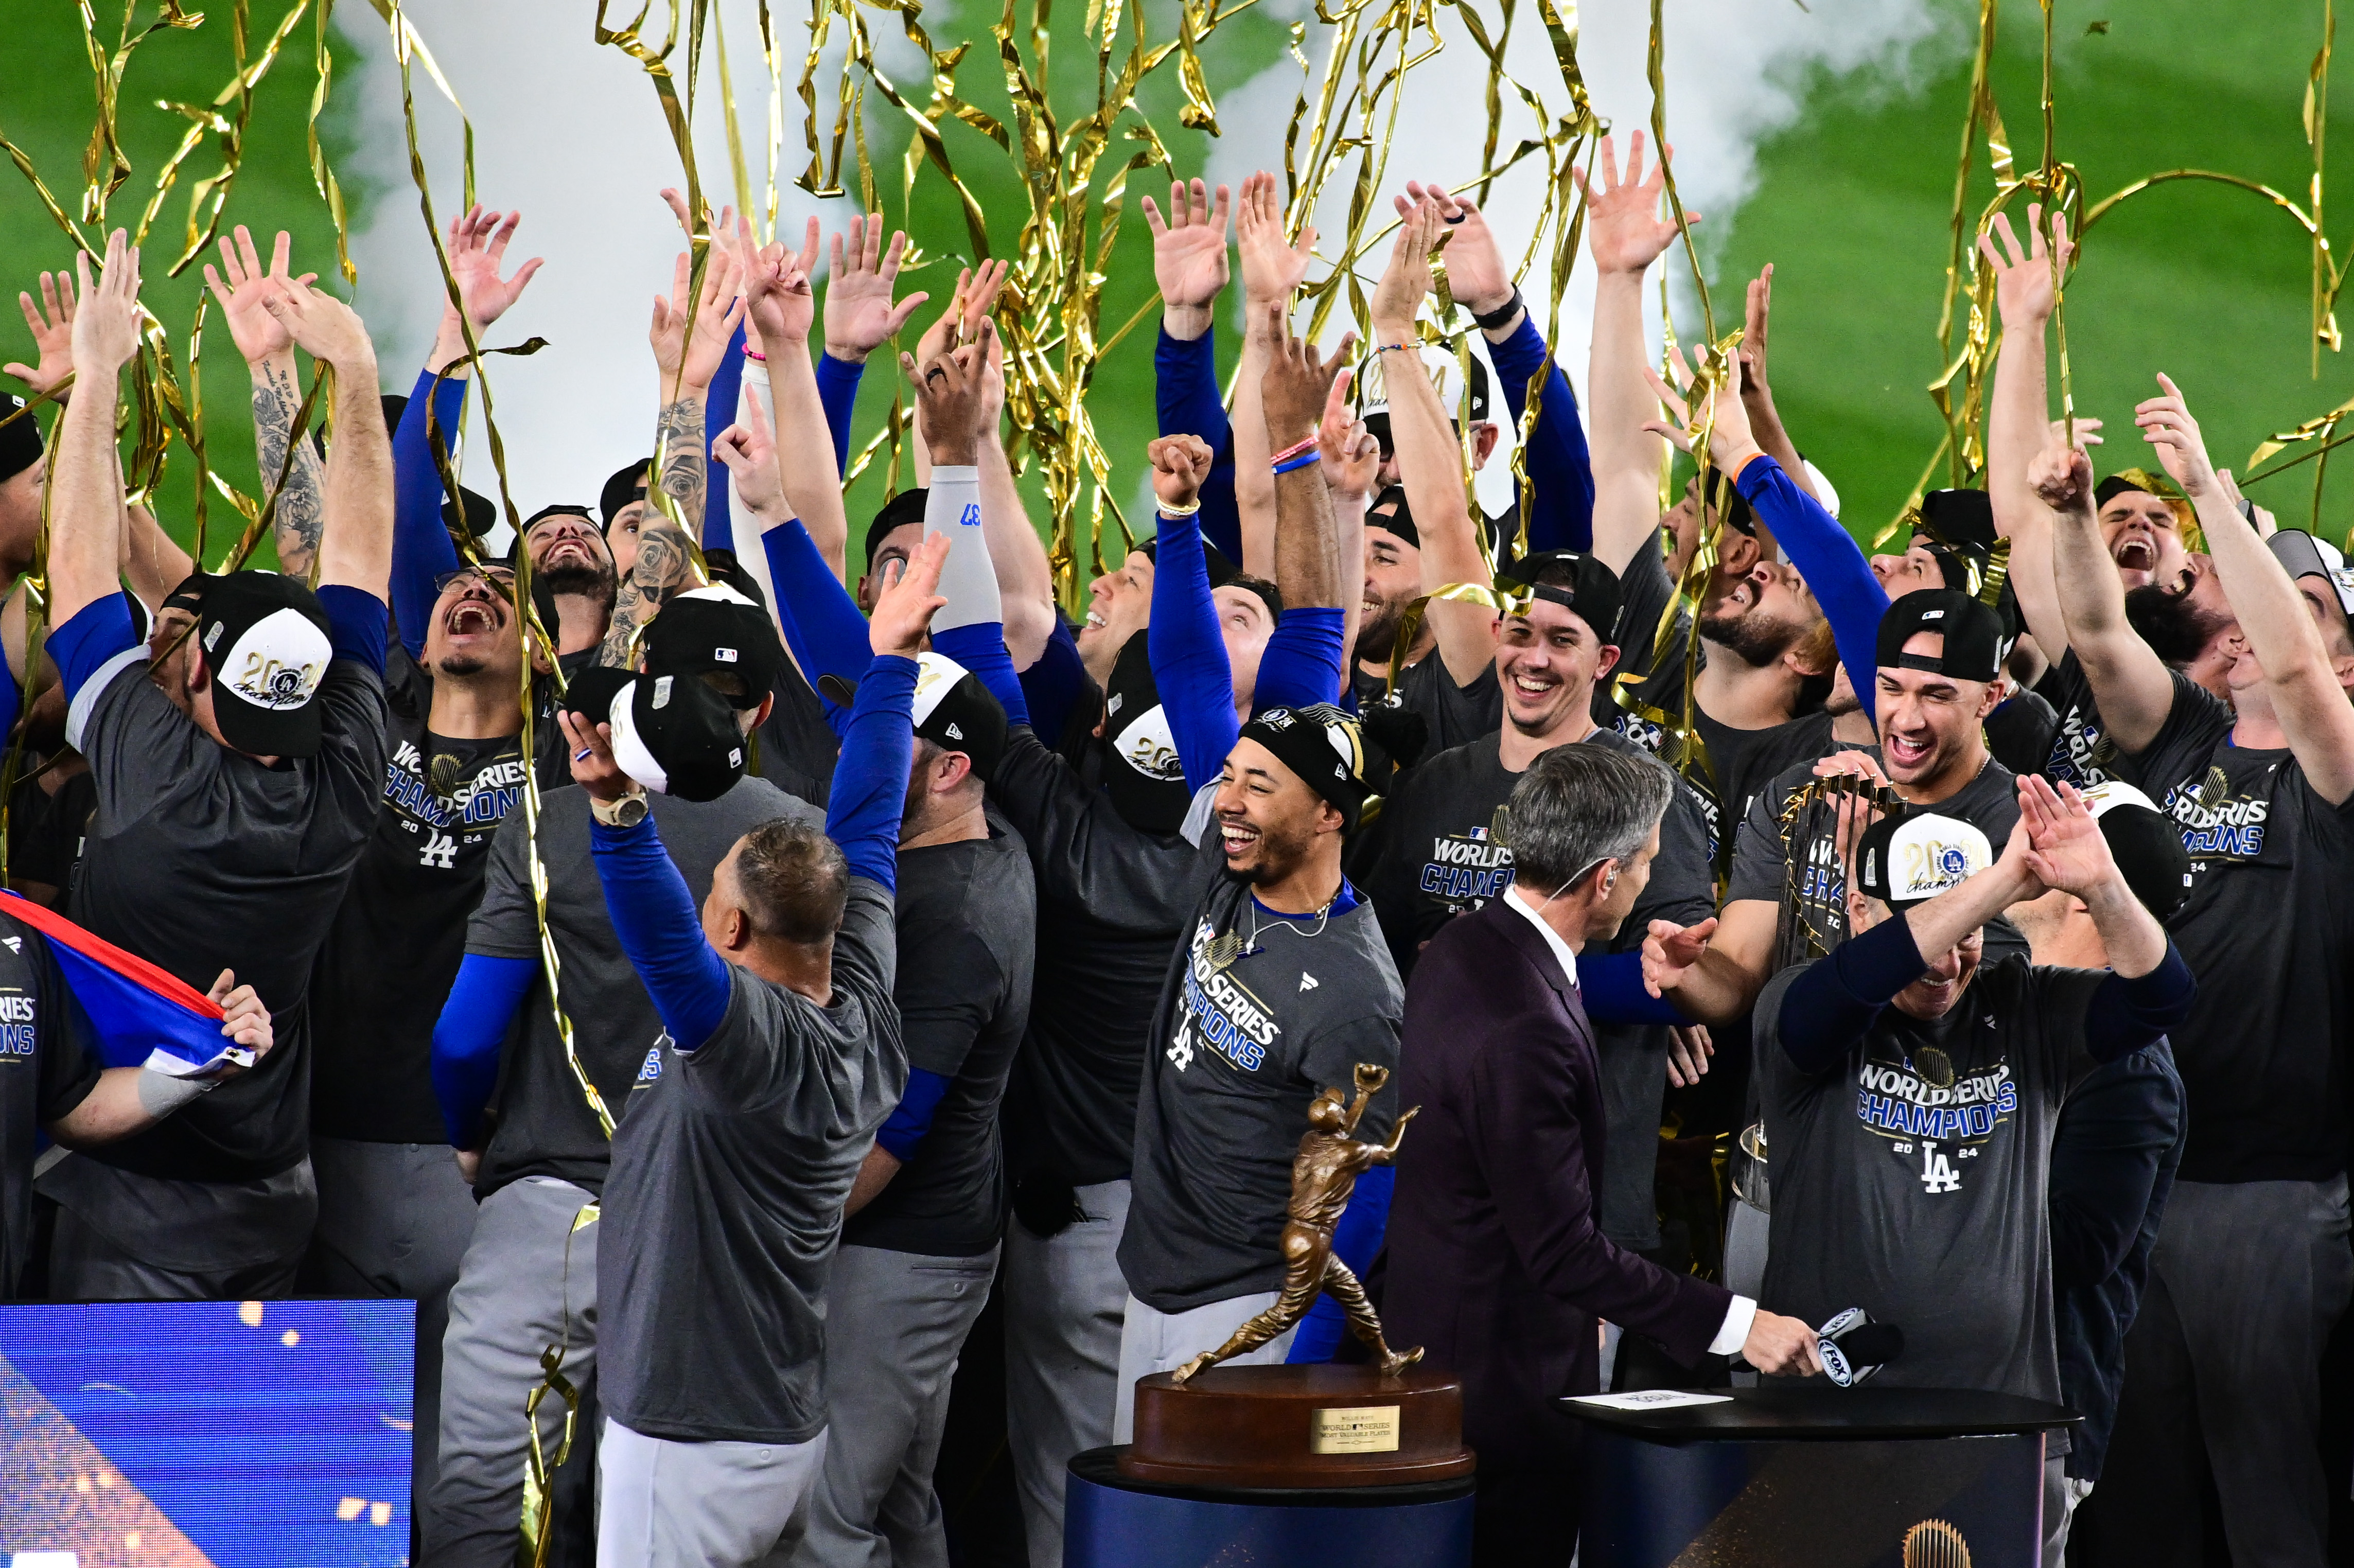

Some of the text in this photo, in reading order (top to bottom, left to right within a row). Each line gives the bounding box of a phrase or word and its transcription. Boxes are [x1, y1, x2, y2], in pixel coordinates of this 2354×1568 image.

[960, 503, 980, 526] 37
[1132, 737, 1174, 768] 20
[400, 820, 483, 844] 20 24
[419, 825, 458, 869] LA
[1434, 837, 1507, 868] WORLD
[1946, 852, 1961, 871] LA
[1419, 862, 1516, 898] CHAMPI
[1205, 974, 1279, 1045] SERIES
[1166, 1007, 1194, 1072] LA
[1859, 1064, 1951, 1106] WORLD
[1893, 1142, 1978, 1158] 20 24
[1921, 1141, 1960, 1194] LA
[1822, 1351, 1838, 1379] SPORTS
[1826, 1349, 1847, 1376] FOX
